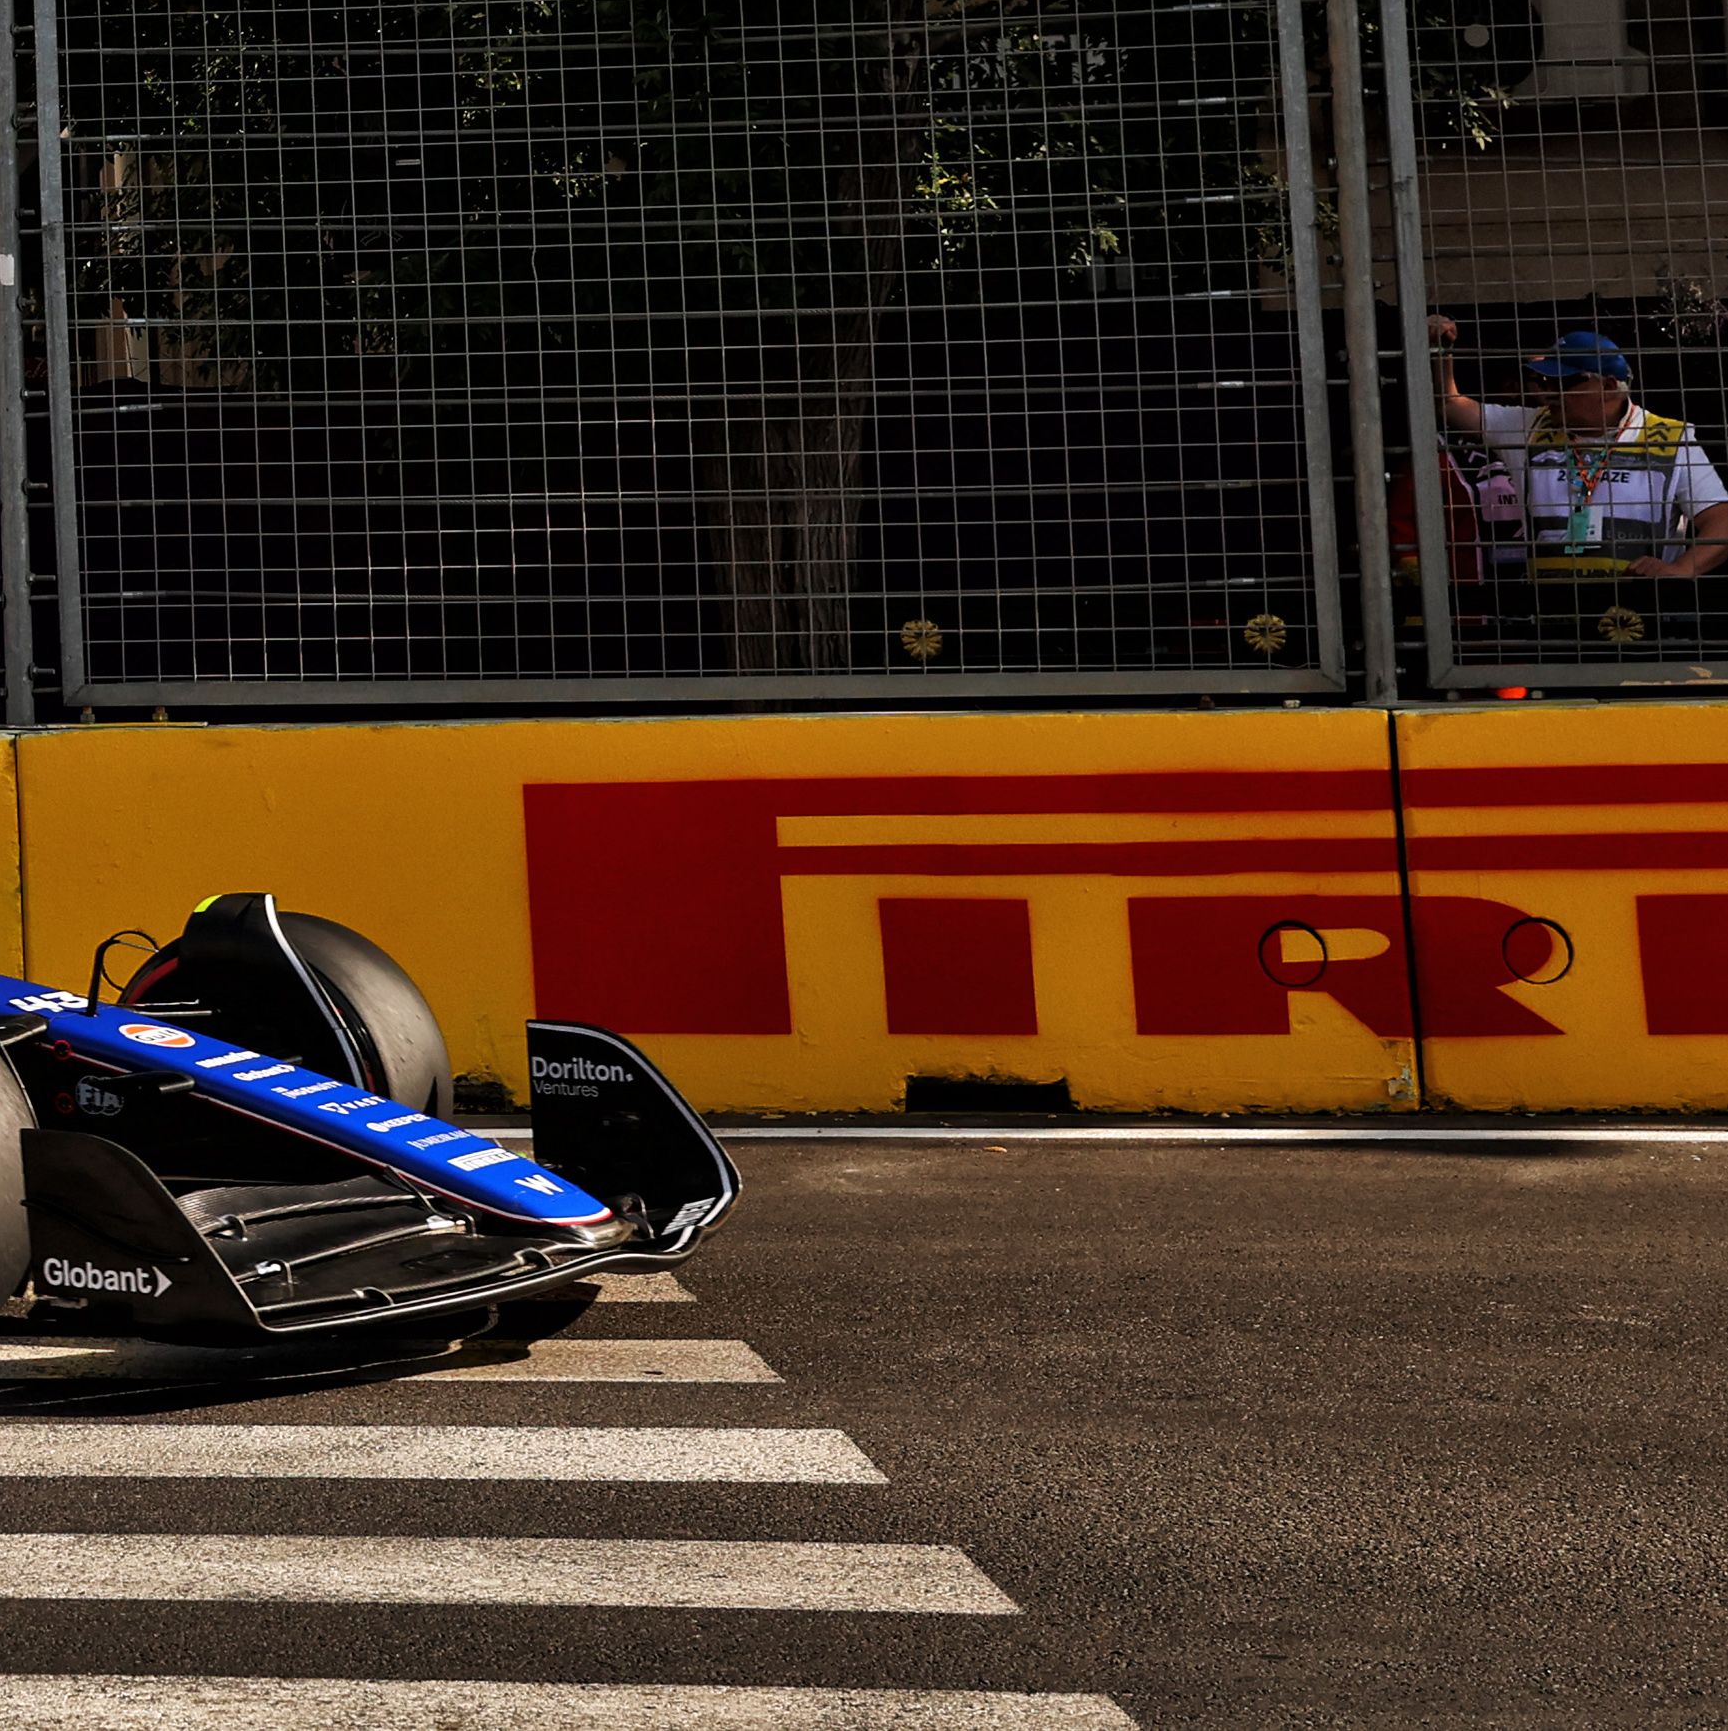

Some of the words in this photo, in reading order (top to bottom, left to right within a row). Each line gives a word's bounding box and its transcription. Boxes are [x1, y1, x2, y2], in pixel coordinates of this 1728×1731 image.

[8, 990, 91, 1013] 43
[134, 1027, 180, 1044] Gulf
[79, 1083, 122, 1109] FIA
[532, 1079, 600, 1098] Ventures
[342, 1095, 387, 1110] VAST
[385, 1113, 431, 1131] KEEPER
[43, 1256, 153, 1295] Globant
